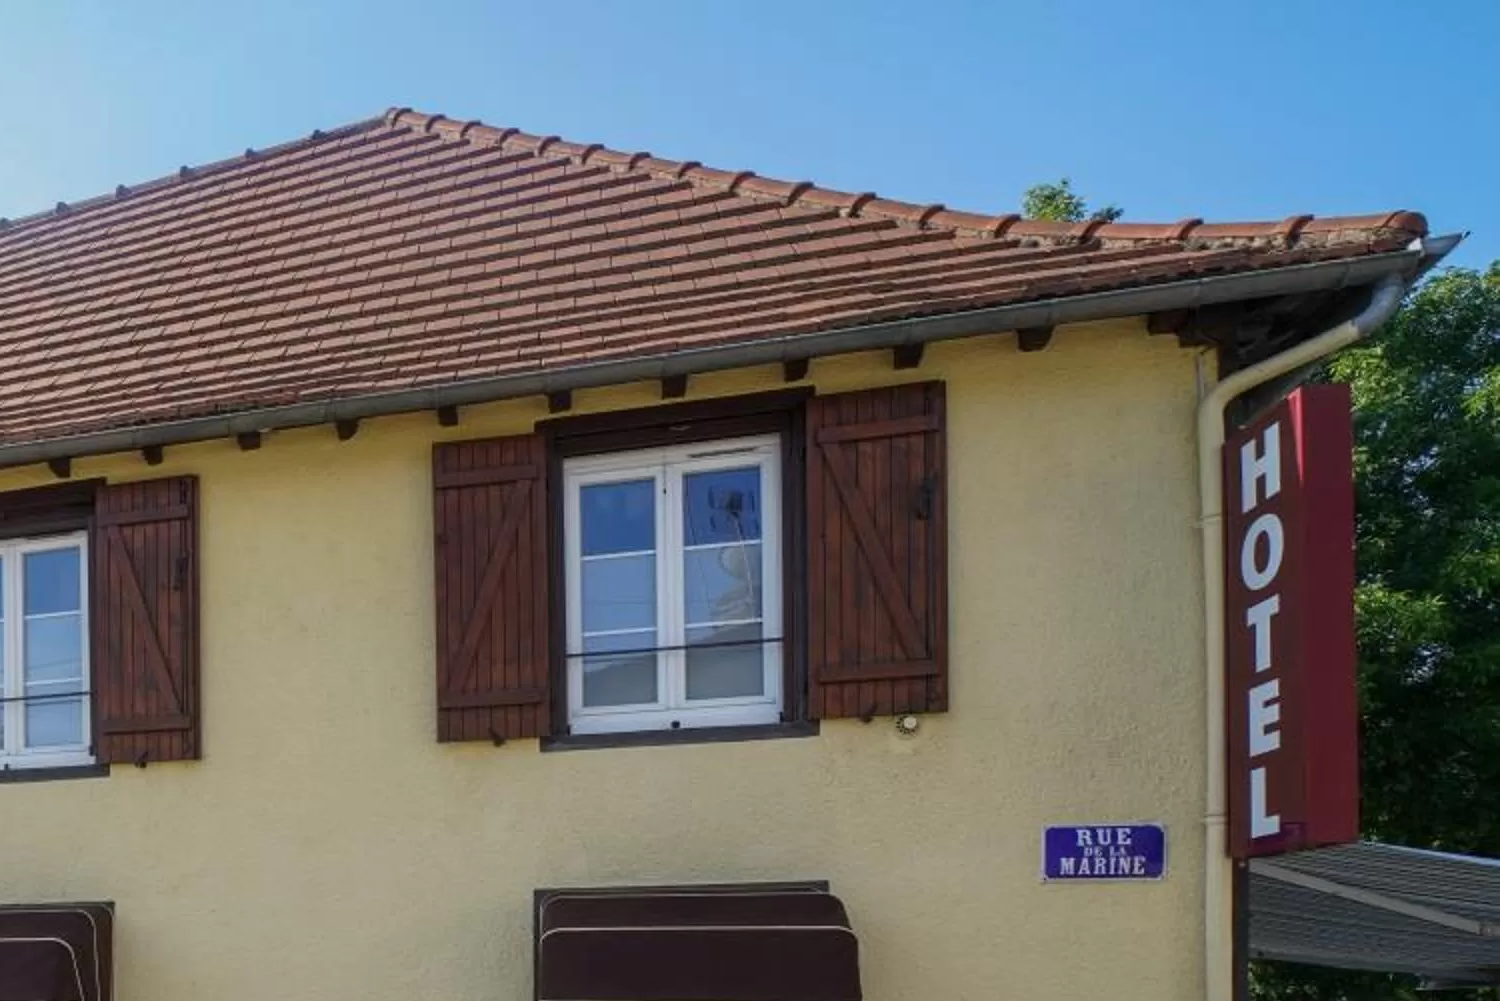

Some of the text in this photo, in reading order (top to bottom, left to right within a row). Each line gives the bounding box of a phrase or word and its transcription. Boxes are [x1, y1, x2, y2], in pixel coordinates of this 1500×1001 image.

[1240, 421, 1285, 840] HOTEL
[1076, 828, 1132, 846] RUE
[1084, 845, 1128, 857] DE LA
[1060, 856, 1147, 875] MARINE
